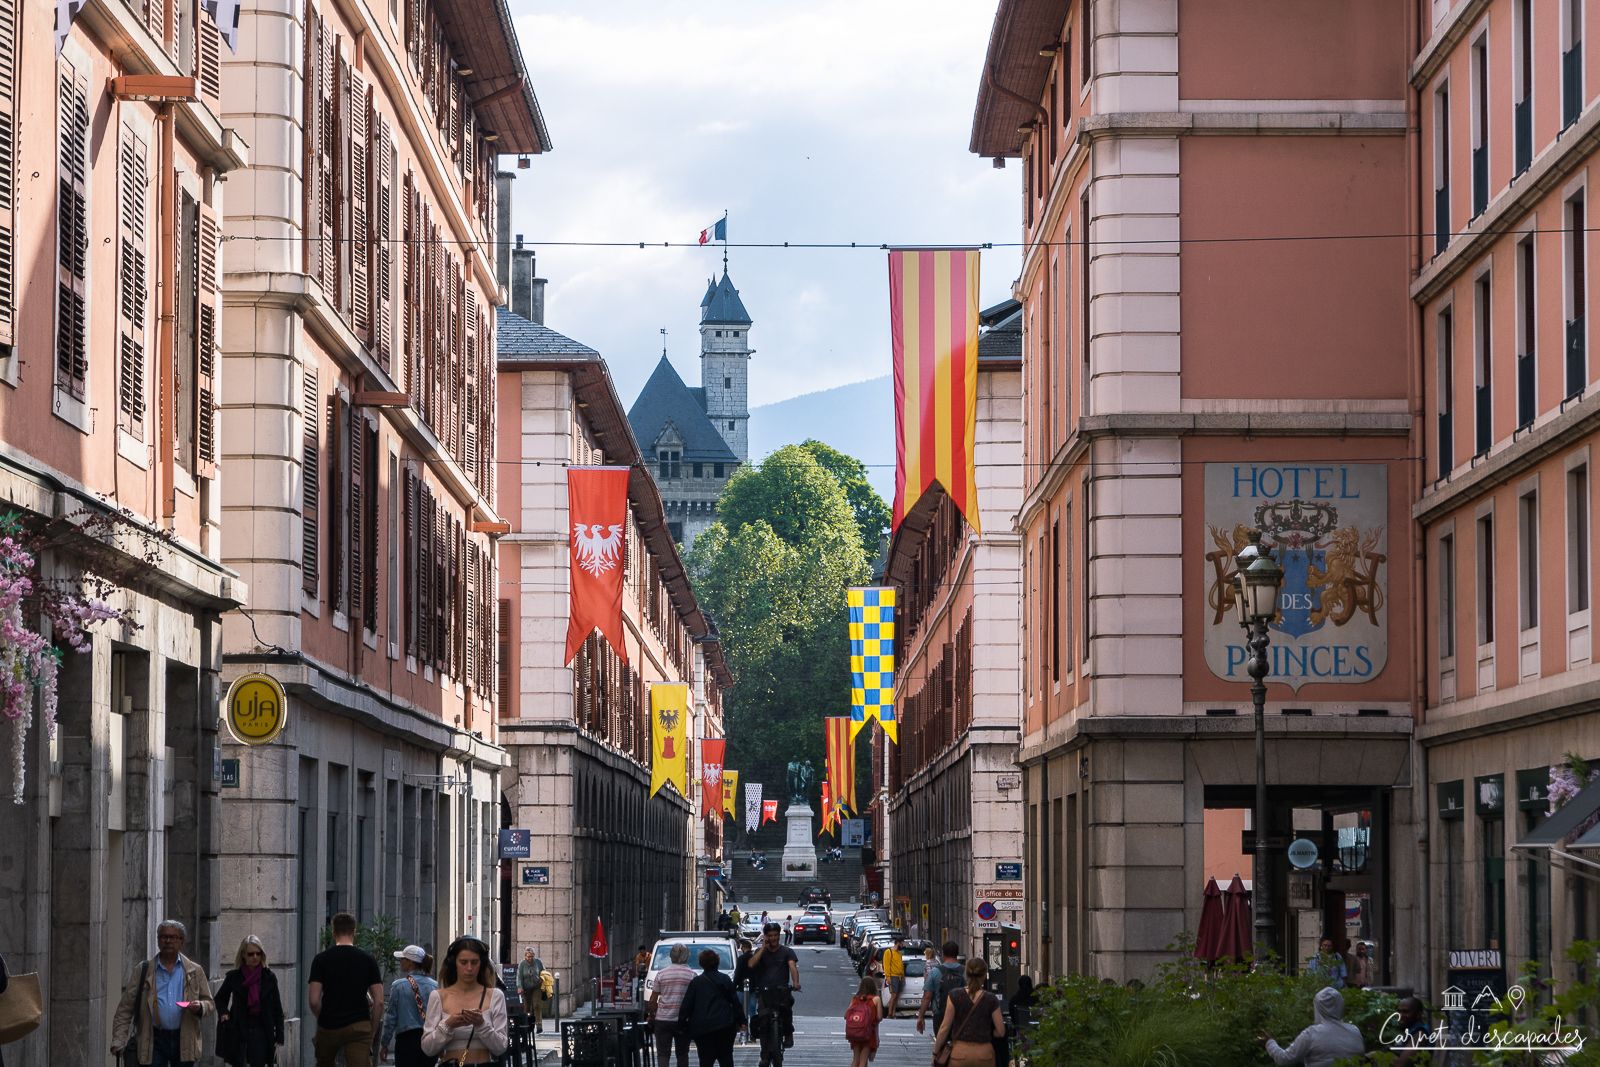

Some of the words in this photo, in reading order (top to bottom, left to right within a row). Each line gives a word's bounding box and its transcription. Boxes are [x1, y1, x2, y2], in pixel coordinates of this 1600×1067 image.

[1232, 466, 1360, 498] HOTEL
[1281, 593, 1313, 610] DES
[1225, 645, 1373, 677] PINCES
